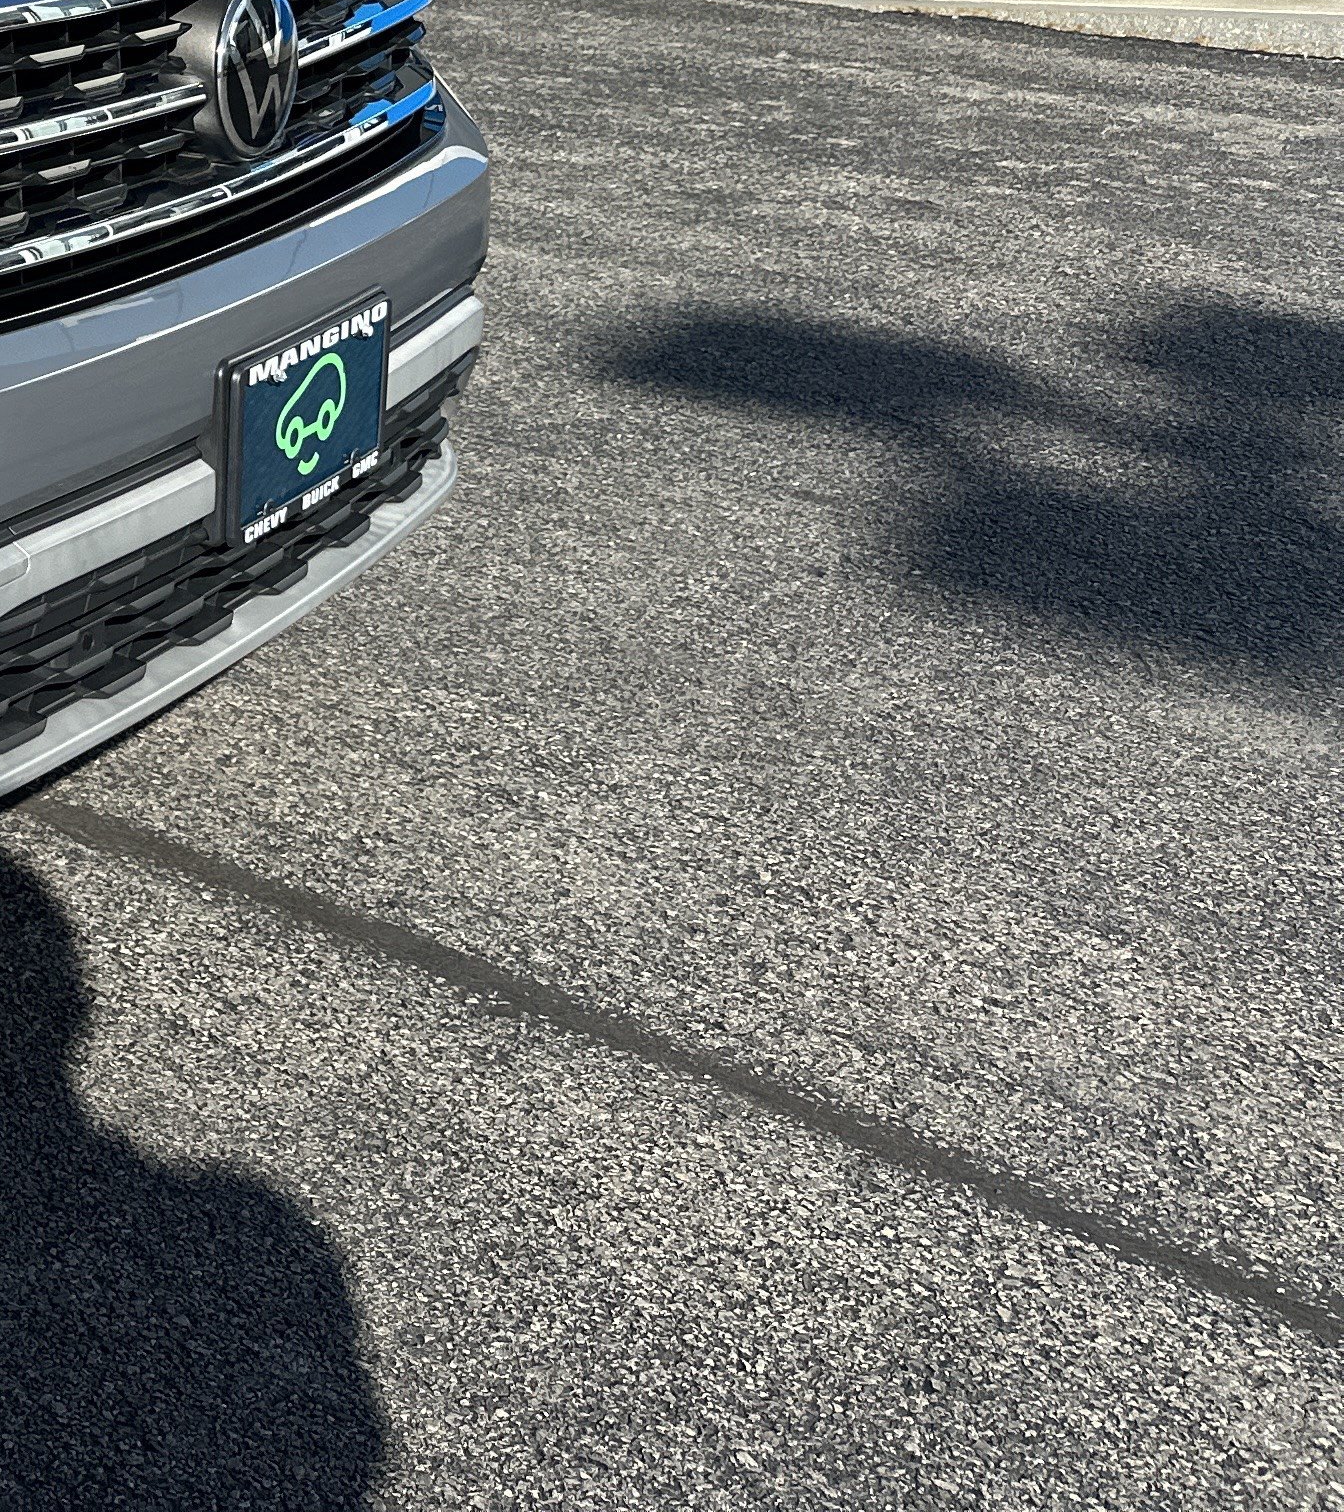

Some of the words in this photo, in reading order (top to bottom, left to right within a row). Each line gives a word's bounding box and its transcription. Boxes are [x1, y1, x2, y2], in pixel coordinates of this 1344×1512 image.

[248, 300, 389, 387] MANGINO
[244, 507, 289, 544] CHEVY
[302, 475, 342, 511] BUICK
[352, 450, 380, 479] GMC
